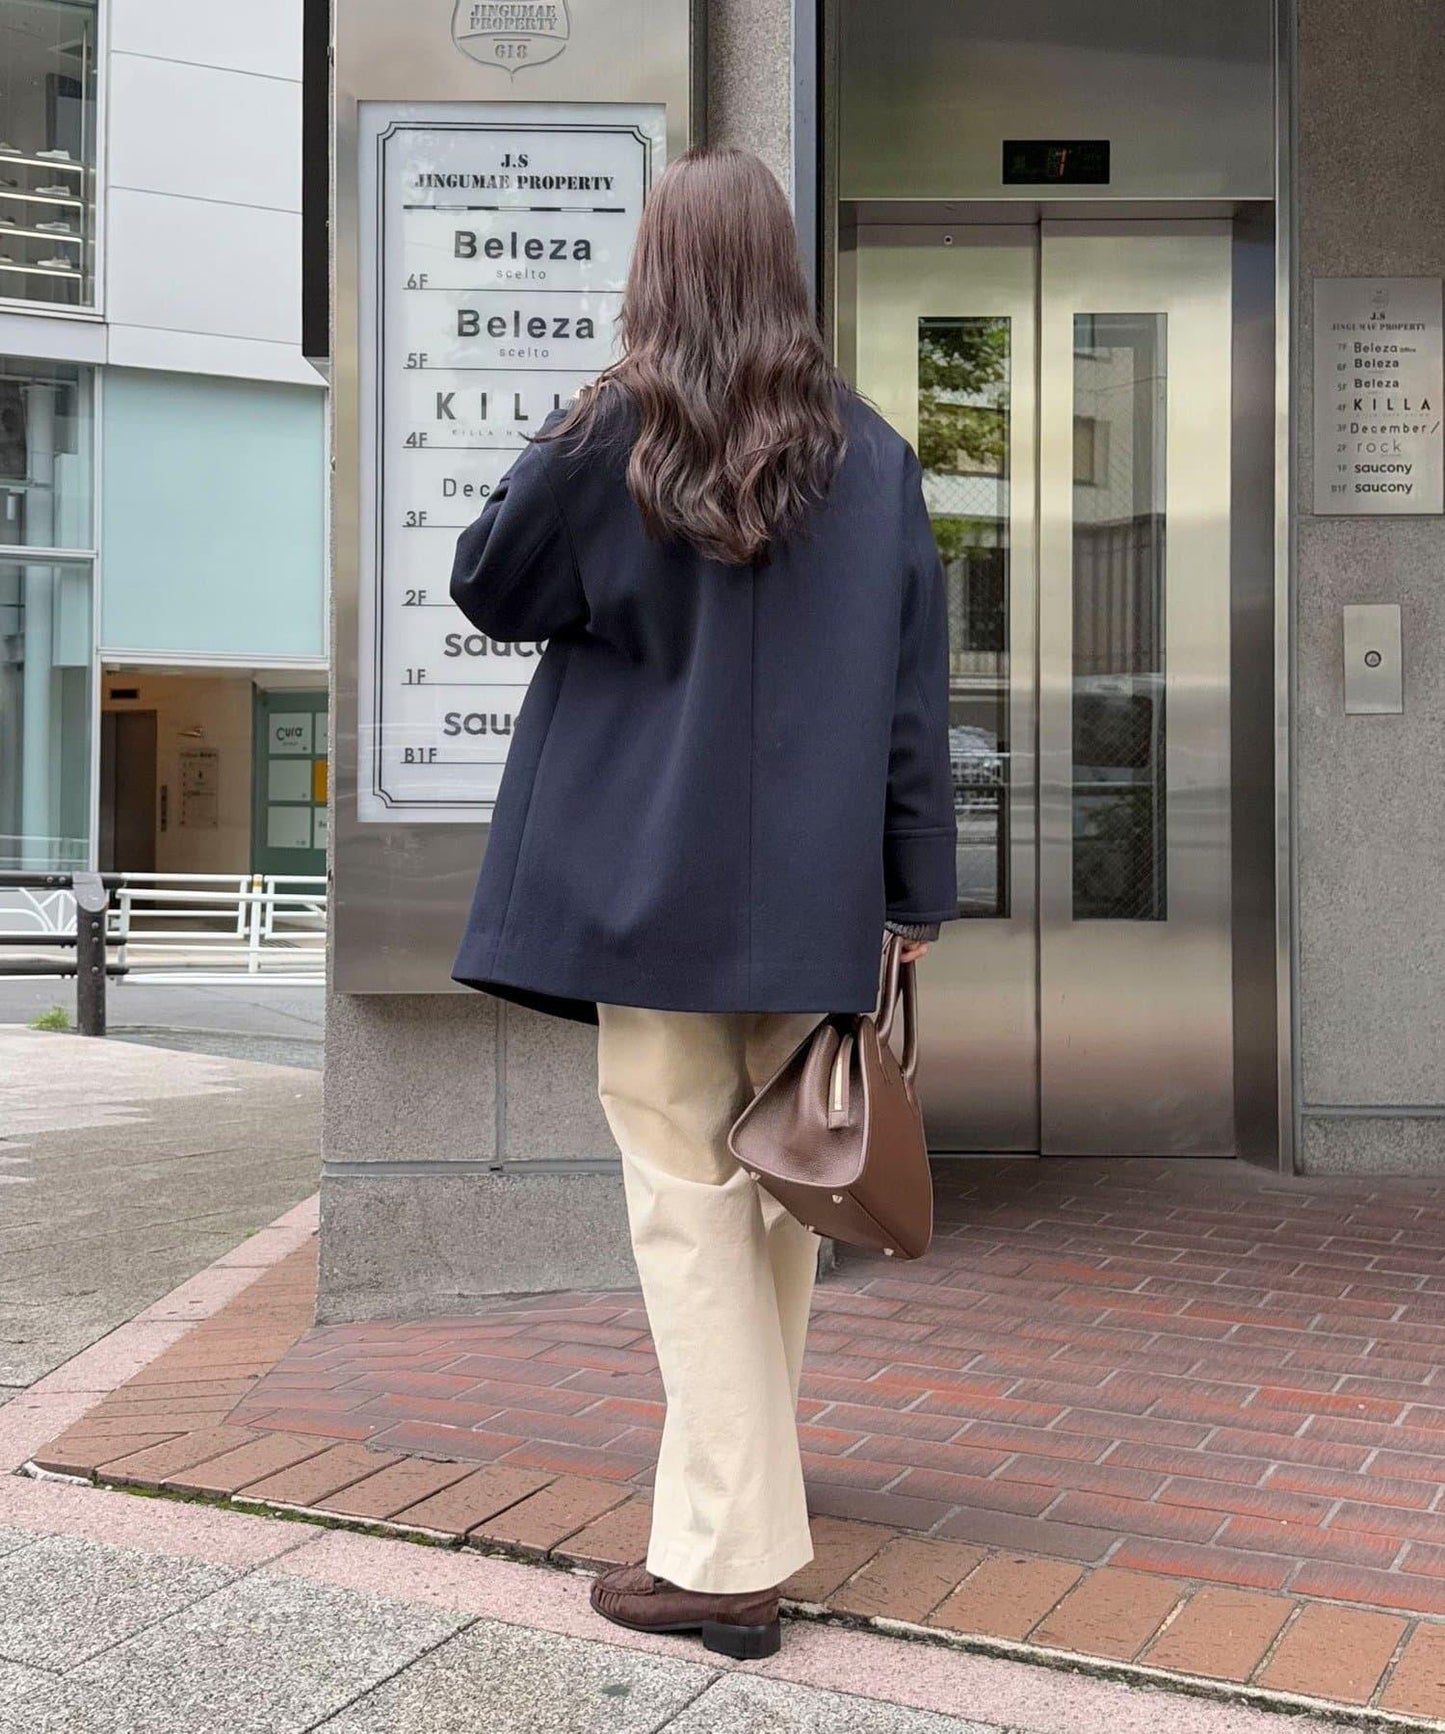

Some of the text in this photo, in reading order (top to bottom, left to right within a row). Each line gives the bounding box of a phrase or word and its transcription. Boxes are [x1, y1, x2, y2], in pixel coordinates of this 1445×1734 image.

[470, 4, 556, 17] JINGUMAE
[470, 17, 557, 30] PROPERTY
[500, 153, 529, 168] J.S
[415, 173, 614, 190] JINGUMAE PROPERTY
[454, 230, 592, 260] Beleza
[407, 273, 429, 289] 6F
[496, 269, 547, 280] scelto
[457, 309, 595, 339] Beleza
[499, 348, 549, 358] scelto
[1354, 342, 1398, 353] Beleza
[407, 352, 429, 369] 5F
[1354, 359, 1399, 368] Beleza
[1354, 379, 1399, 388] Beleza
[1354, 398, 1431, 411] KILLA
[405, 432, 428, 448] 4F
[1357, 439, 1402, 453] rock
[1354, 464, 1412, 475] saucony
[1354, 483, 1413, 494] saucony
[406, 511, 428, 527] 3F
[405, 589, 427, 606] 2F
[406, 668, 426, 684] 1F
[404, 747, 437, 763] B1F
